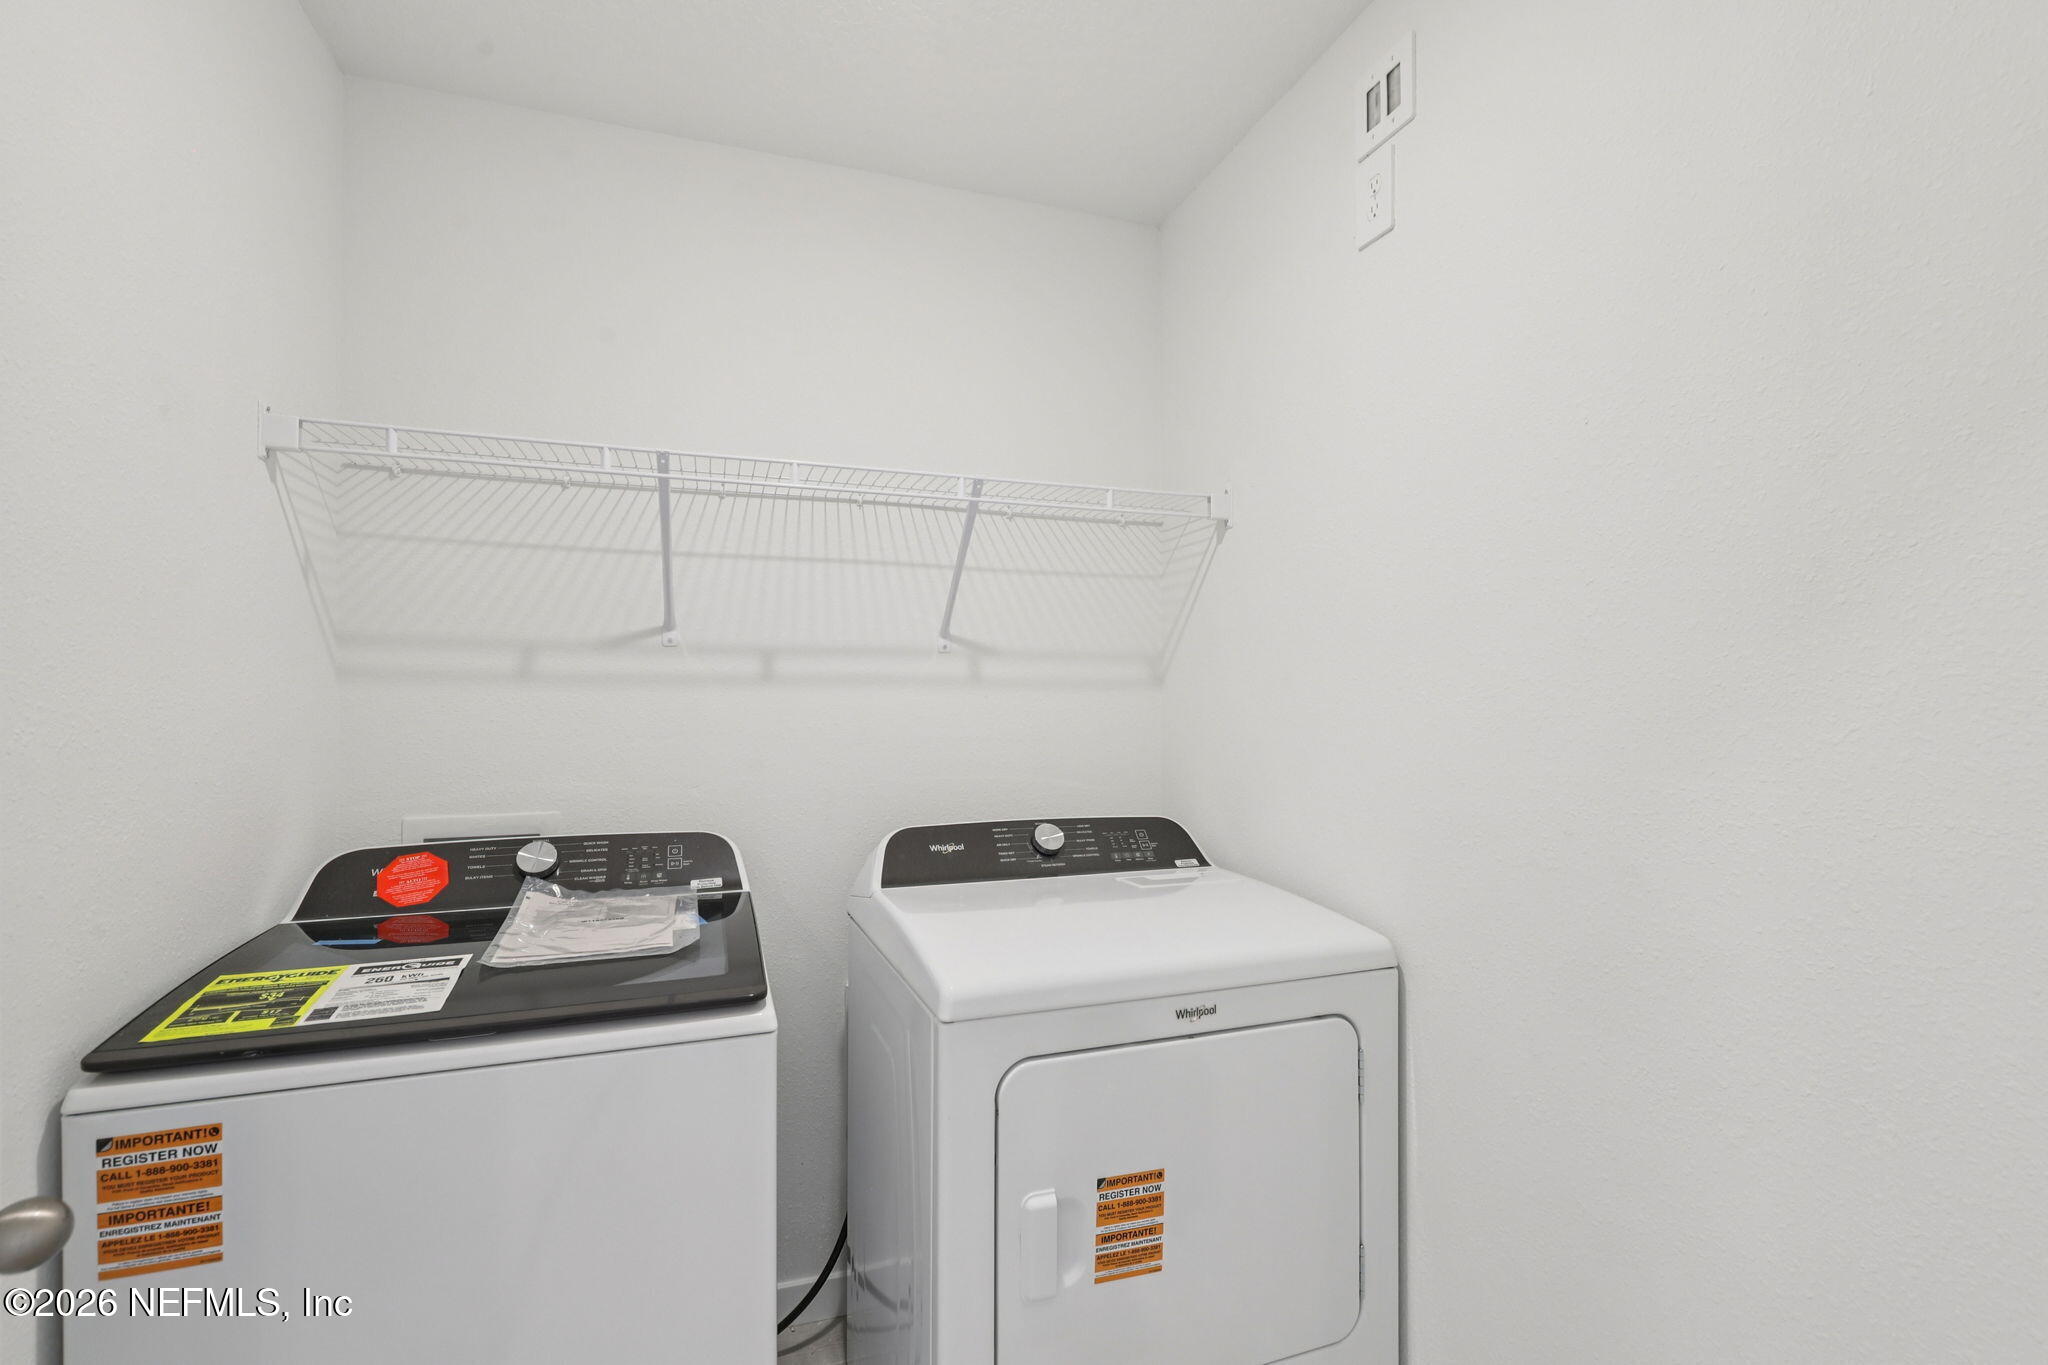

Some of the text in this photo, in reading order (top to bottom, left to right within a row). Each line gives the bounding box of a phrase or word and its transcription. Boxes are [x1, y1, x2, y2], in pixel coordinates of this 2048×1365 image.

[928, 843, 965, 854] Whirlpool
[365, 975, 395, 985] 260
[1175, 1004, 1217, 1022] Whirlpool
[115, 1128, 207, 1150] IMPORTANT!
[101, 1143, 218, 1168] REGISTER NOW
[100, 1159, 219, 1183] CALL 1-888-900-3381
[1106, 1172, 1156, 1188] IMPORTANT!
[1099, 1184, 1162, 1201] REGISTER NOW
[108, 1201, 210, 1226] IMPORTANTE!
[1098, 1203, 1115, 1212] CALL
[99, 1213, 221, 1238] ENREGISTREZ MAINTENANT
[101, 1235, 144, 1248] APPELEZ
[1101, 1227, 1157, 1244] IMPORTANTE!
